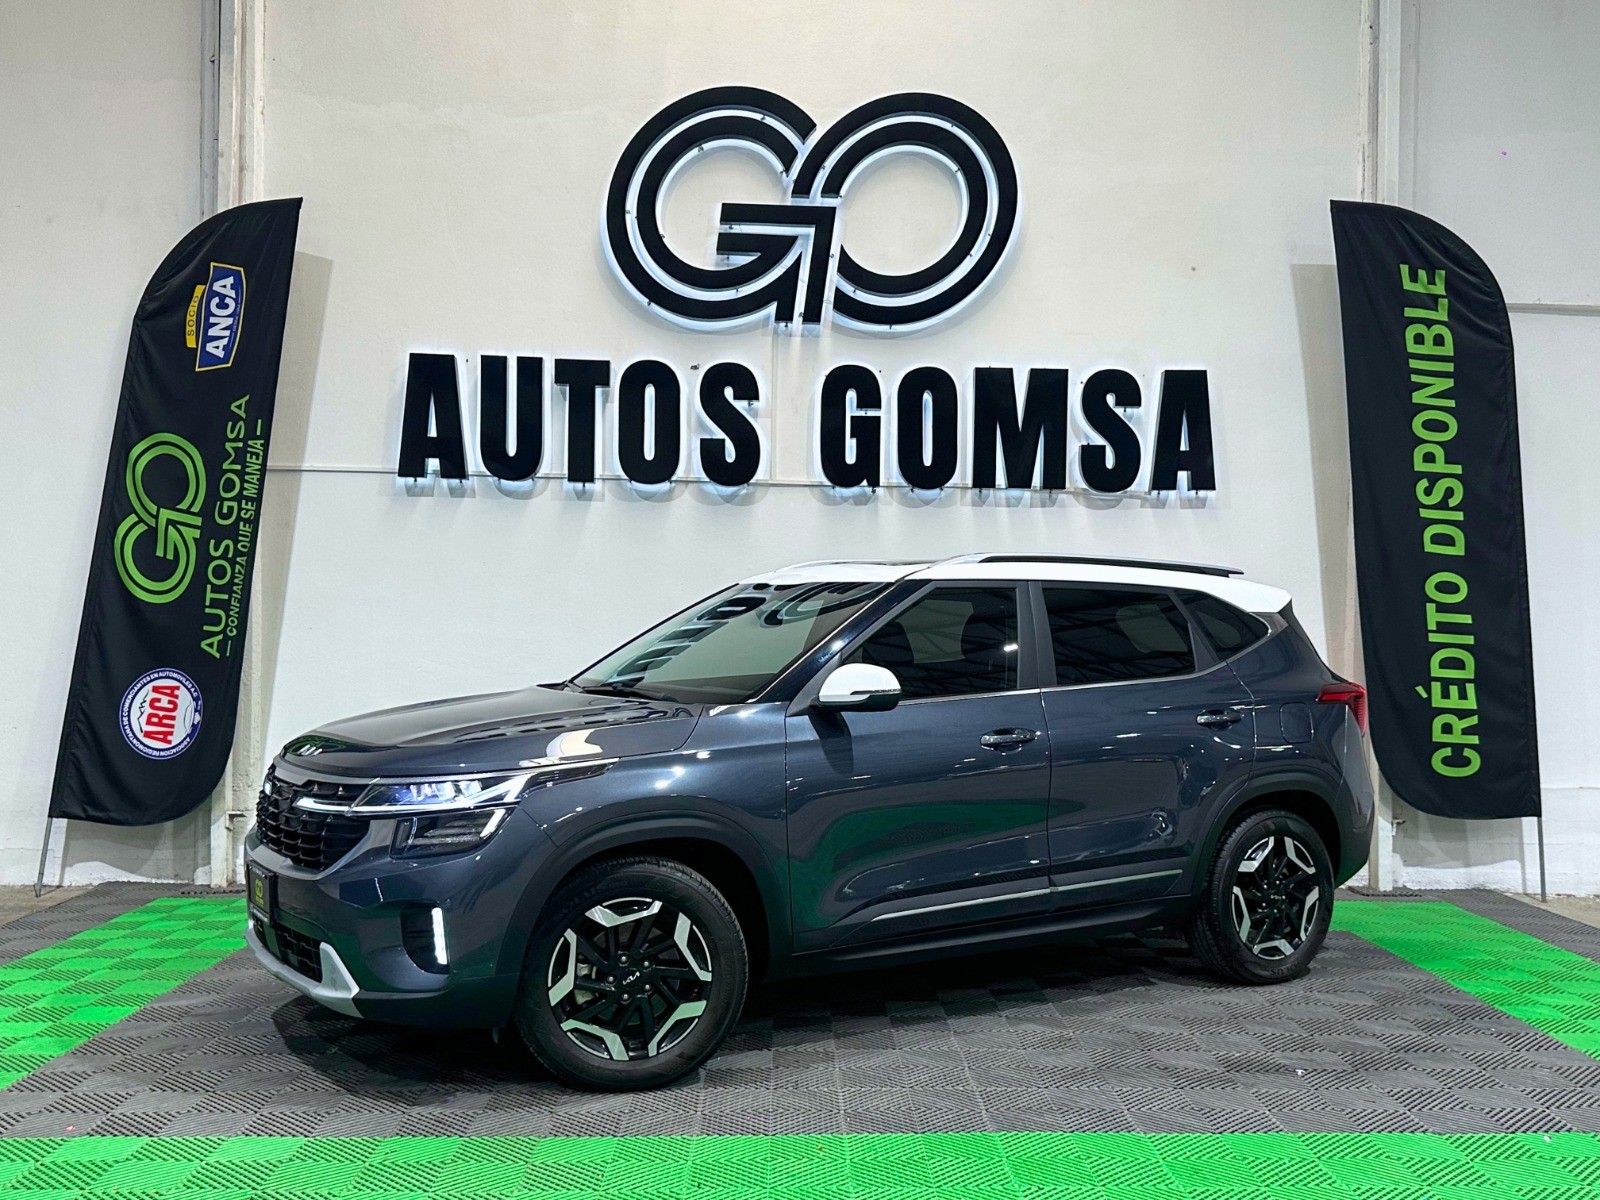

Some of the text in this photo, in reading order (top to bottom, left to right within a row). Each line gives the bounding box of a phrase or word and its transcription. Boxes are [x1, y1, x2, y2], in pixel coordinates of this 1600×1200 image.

[606, 86, 1018, 325] GO
[187, 295, 200, 336] SOCIO
[205, 276, 236, 358] ANCA
[398, 353, 1216, 494] AUTOS GOMSA
[114, 432, 207, 604] GO
[200, 394, 250, 659] AUTOS GOMSA
[227, 439, 265, 636] CONFIANZA QUE SE MANEJA
[1400, 264, 1481, 777] CRÉDITO DISPONIBLE
[144, 685, 180, 745] ARCA
[150, 672, 158, 680] EN
